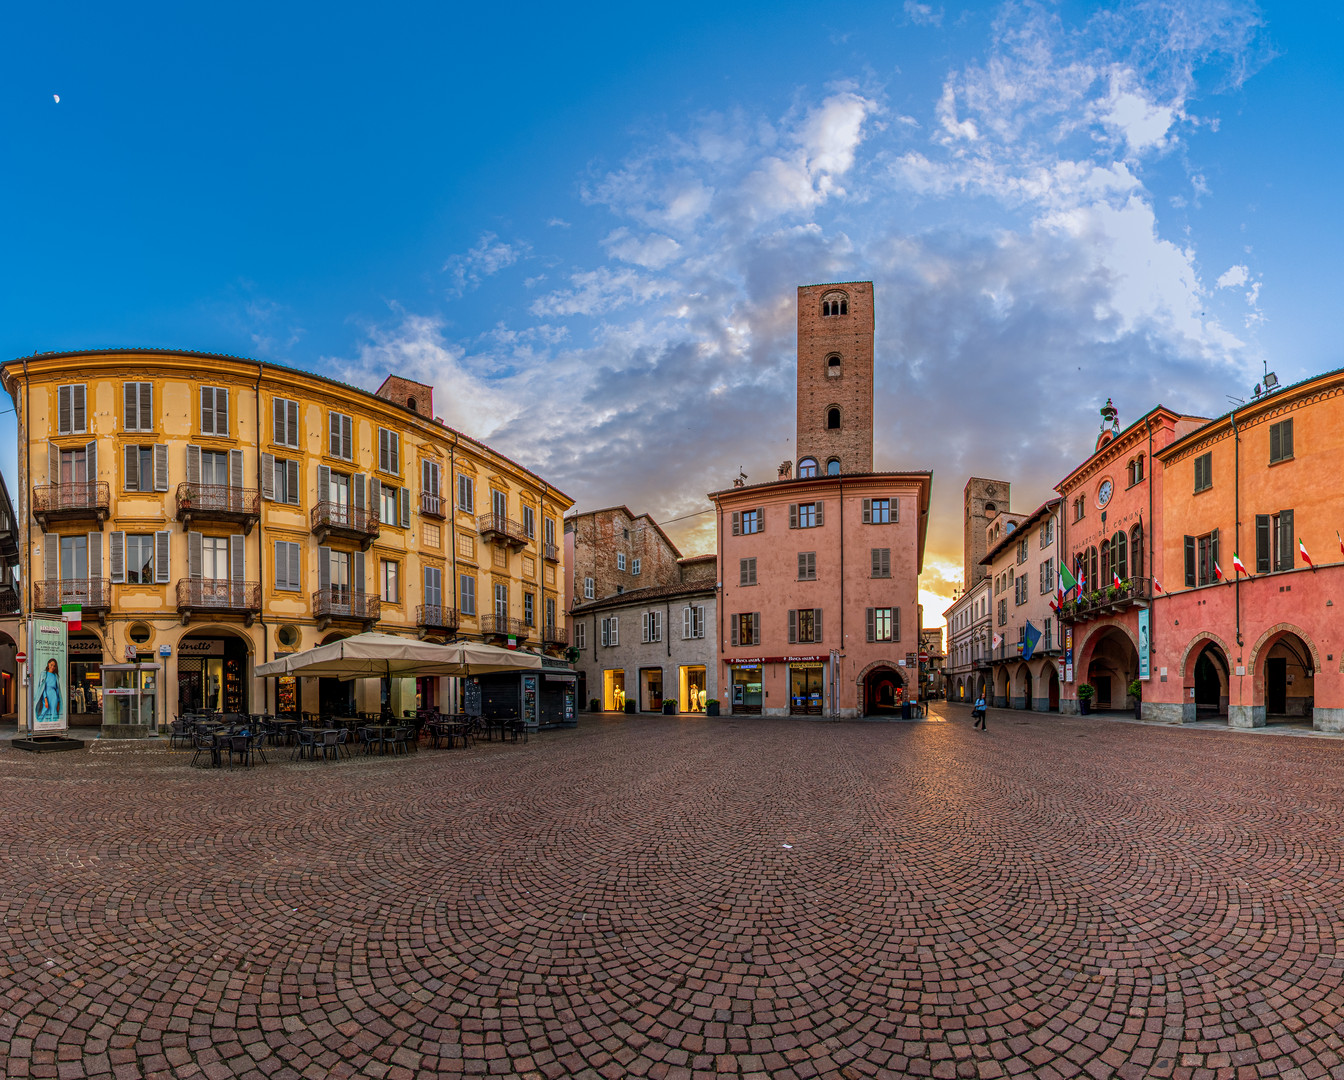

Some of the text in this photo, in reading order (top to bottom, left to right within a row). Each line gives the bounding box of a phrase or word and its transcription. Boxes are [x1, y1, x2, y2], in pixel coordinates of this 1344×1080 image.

[1072, 507, 1144, 550] PALAZZO DEL COMUNE
